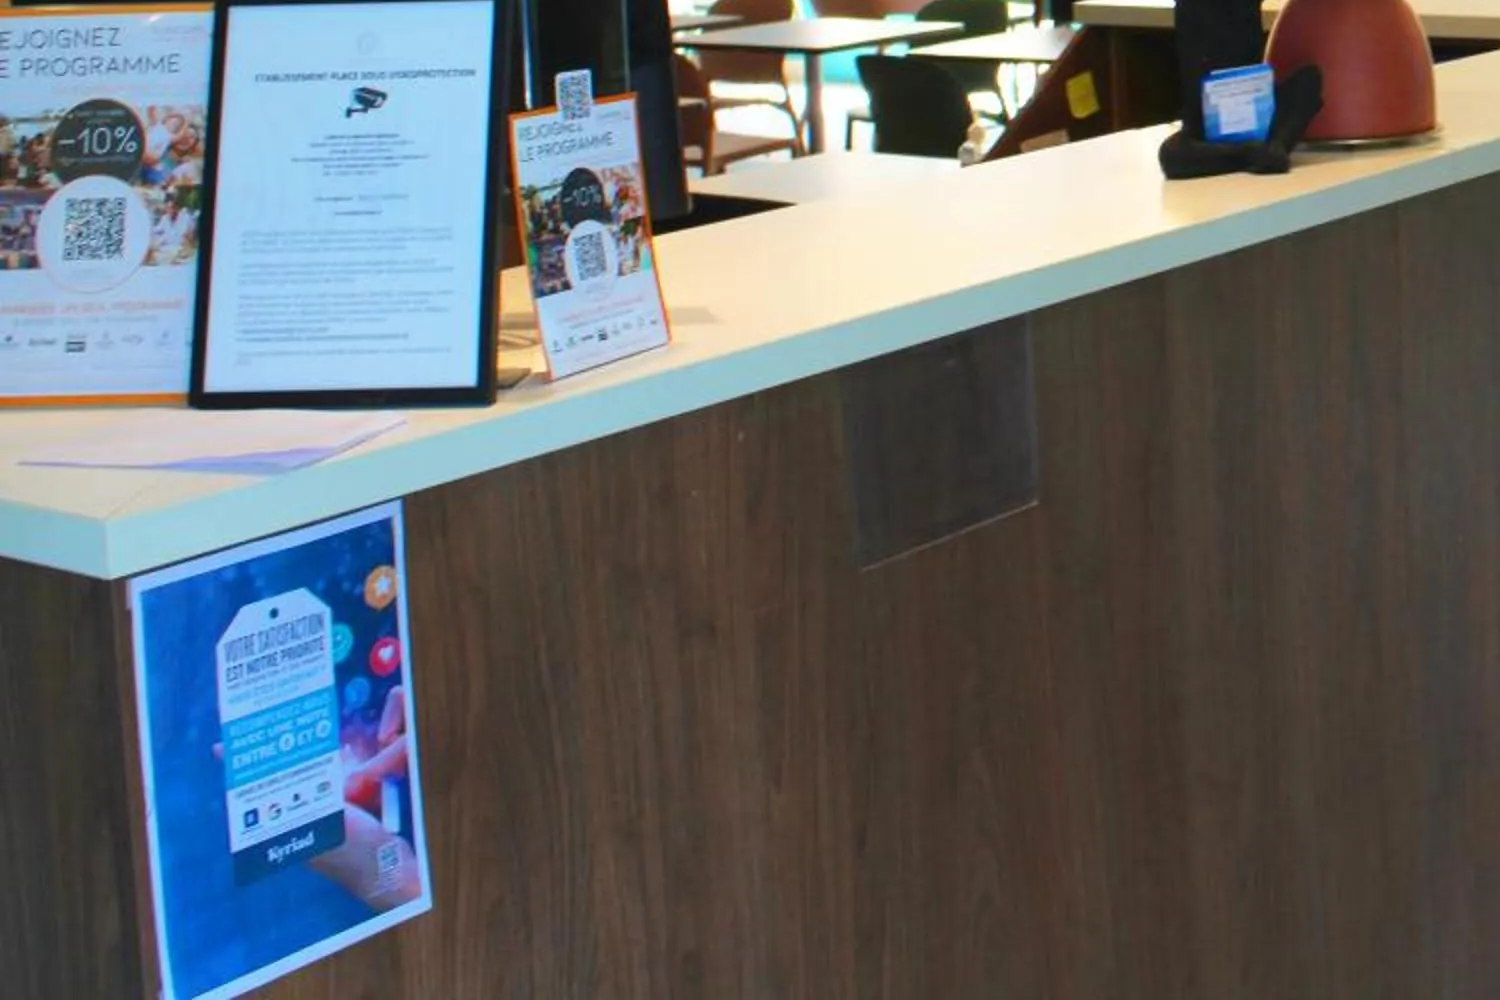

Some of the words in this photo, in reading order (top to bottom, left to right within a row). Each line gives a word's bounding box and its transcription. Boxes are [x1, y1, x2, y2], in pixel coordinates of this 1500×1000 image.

[0, 27, 122, 50] EJOIGNEZ
[0, 58, 11, 79] E
[19, 53, 182, 78] PROGRAMME
[57, 125, 139, 156] -10%
[536, 130, 614, 157] PROGRAMME
[226, 663, 244, 683] EST
[246, 651, 279, 675] NOTRE
[266, 830, 315, 864] Kyriad
